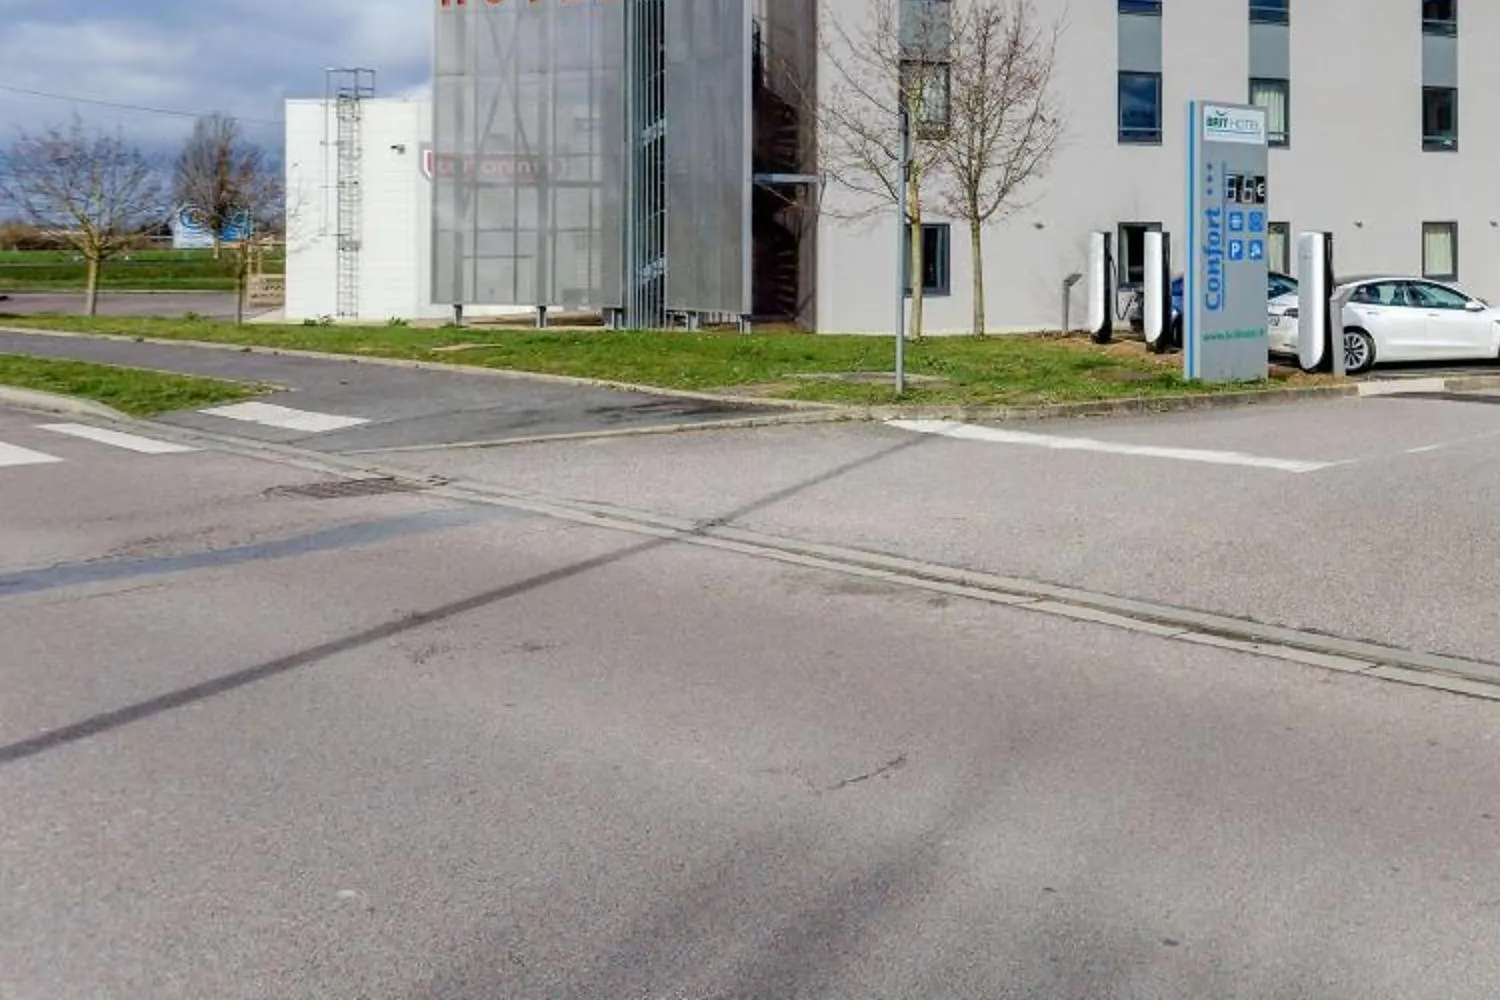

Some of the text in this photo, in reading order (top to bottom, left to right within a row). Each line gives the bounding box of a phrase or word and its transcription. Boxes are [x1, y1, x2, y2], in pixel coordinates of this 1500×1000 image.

[1206, 116, 1259, 130] BRIT HOTEL
[1202, 207, 1223, 310] Confort
